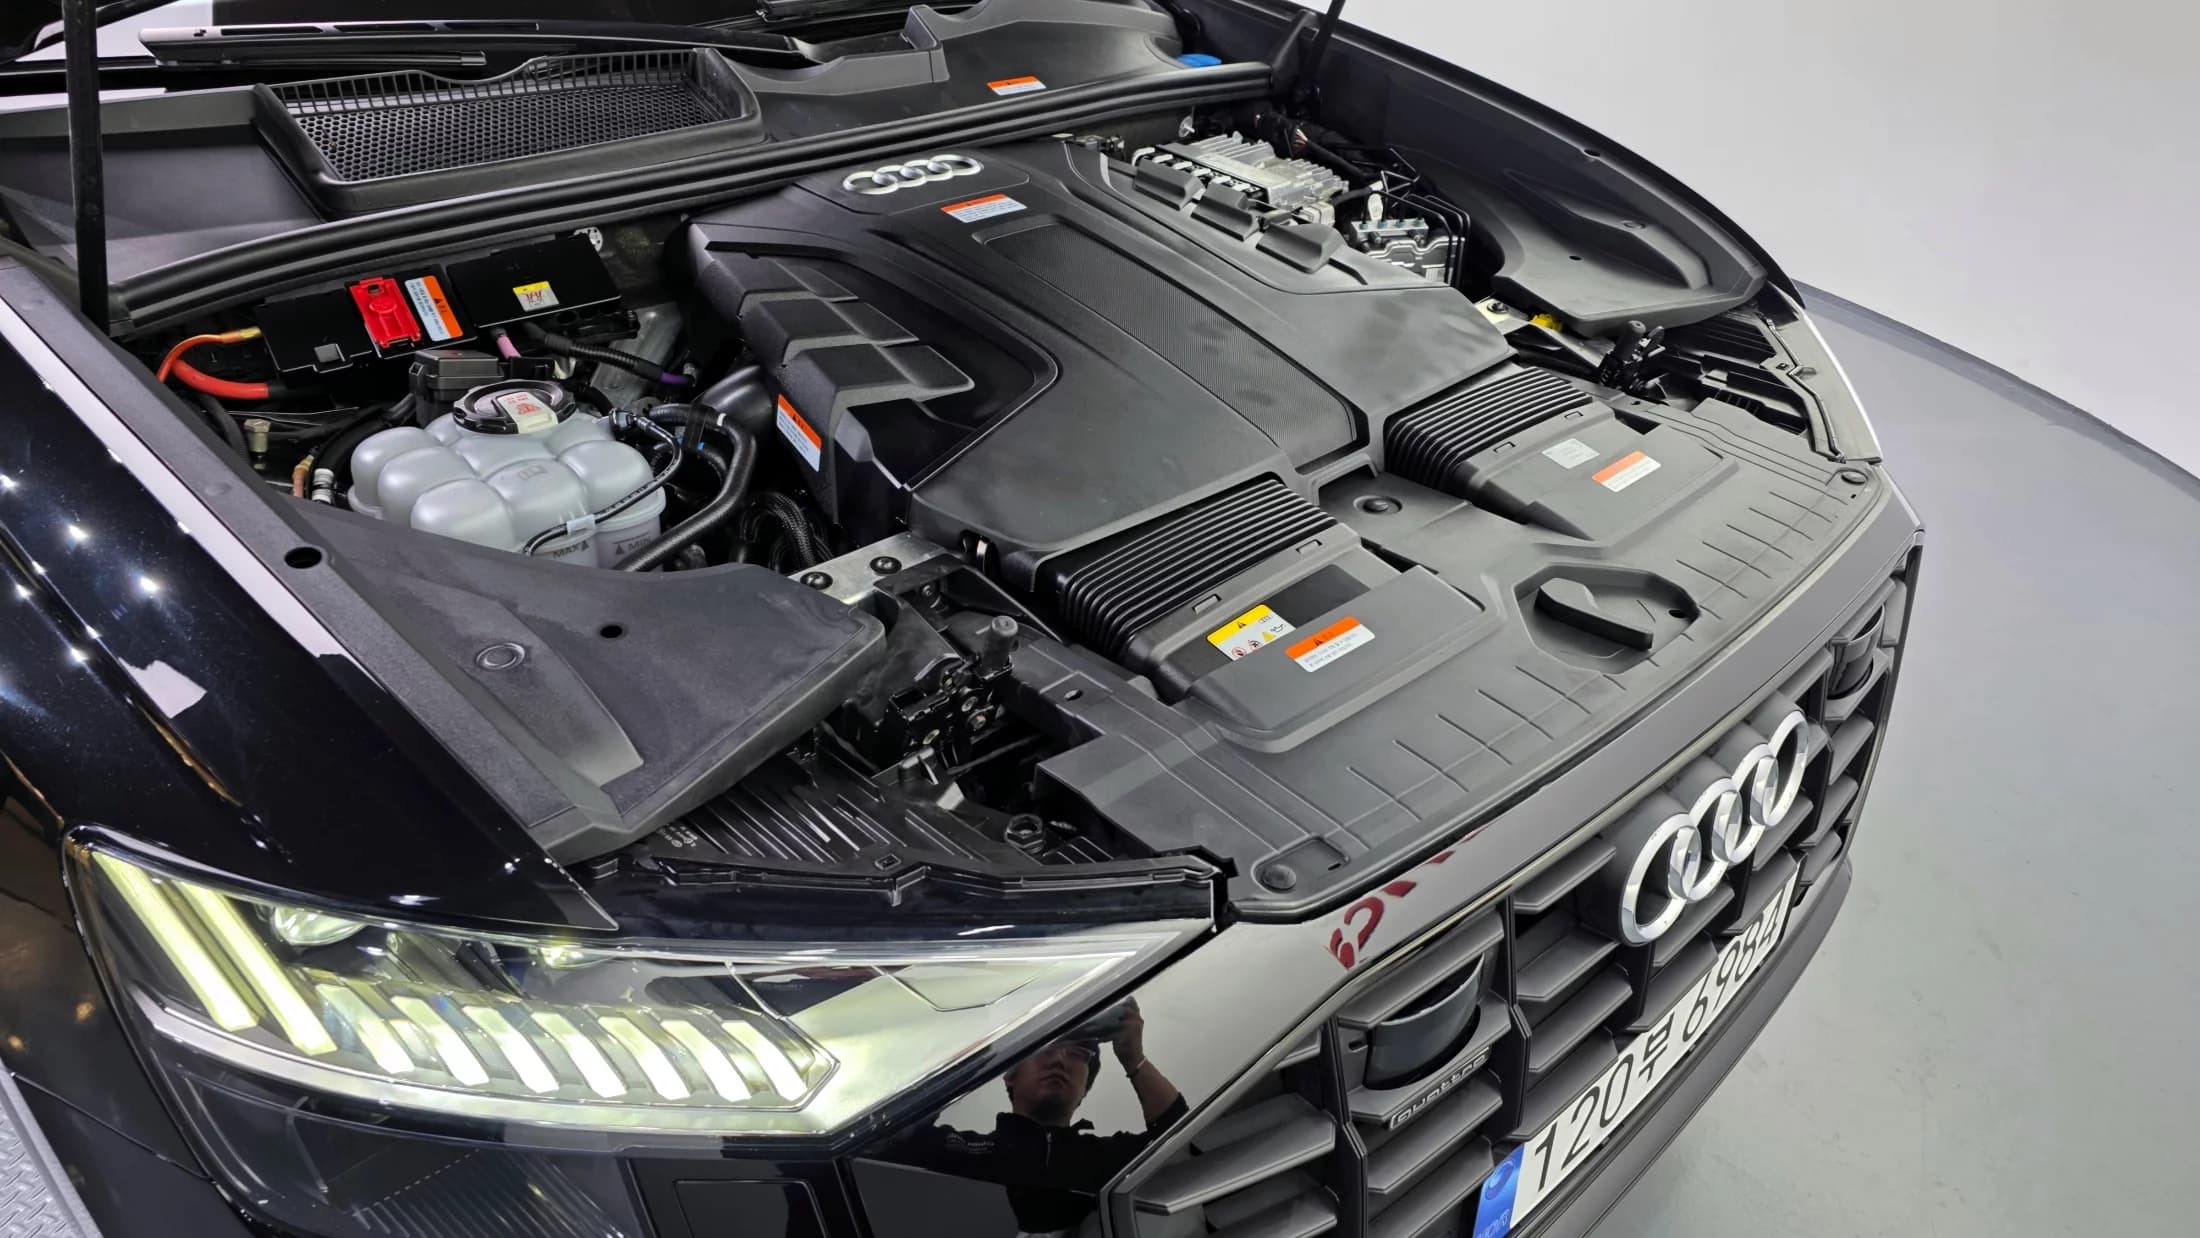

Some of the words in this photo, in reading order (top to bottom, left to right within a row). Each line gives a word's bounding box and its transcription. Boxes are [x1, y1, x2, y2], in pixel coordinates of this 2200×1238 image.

[553, 545, 580, 558] MAX
[1534, 1011, 1675, 1192] 120부
[1682, 887, 1786, 1042] 6984
[1396, 1053, 1486, 1124] quattro
